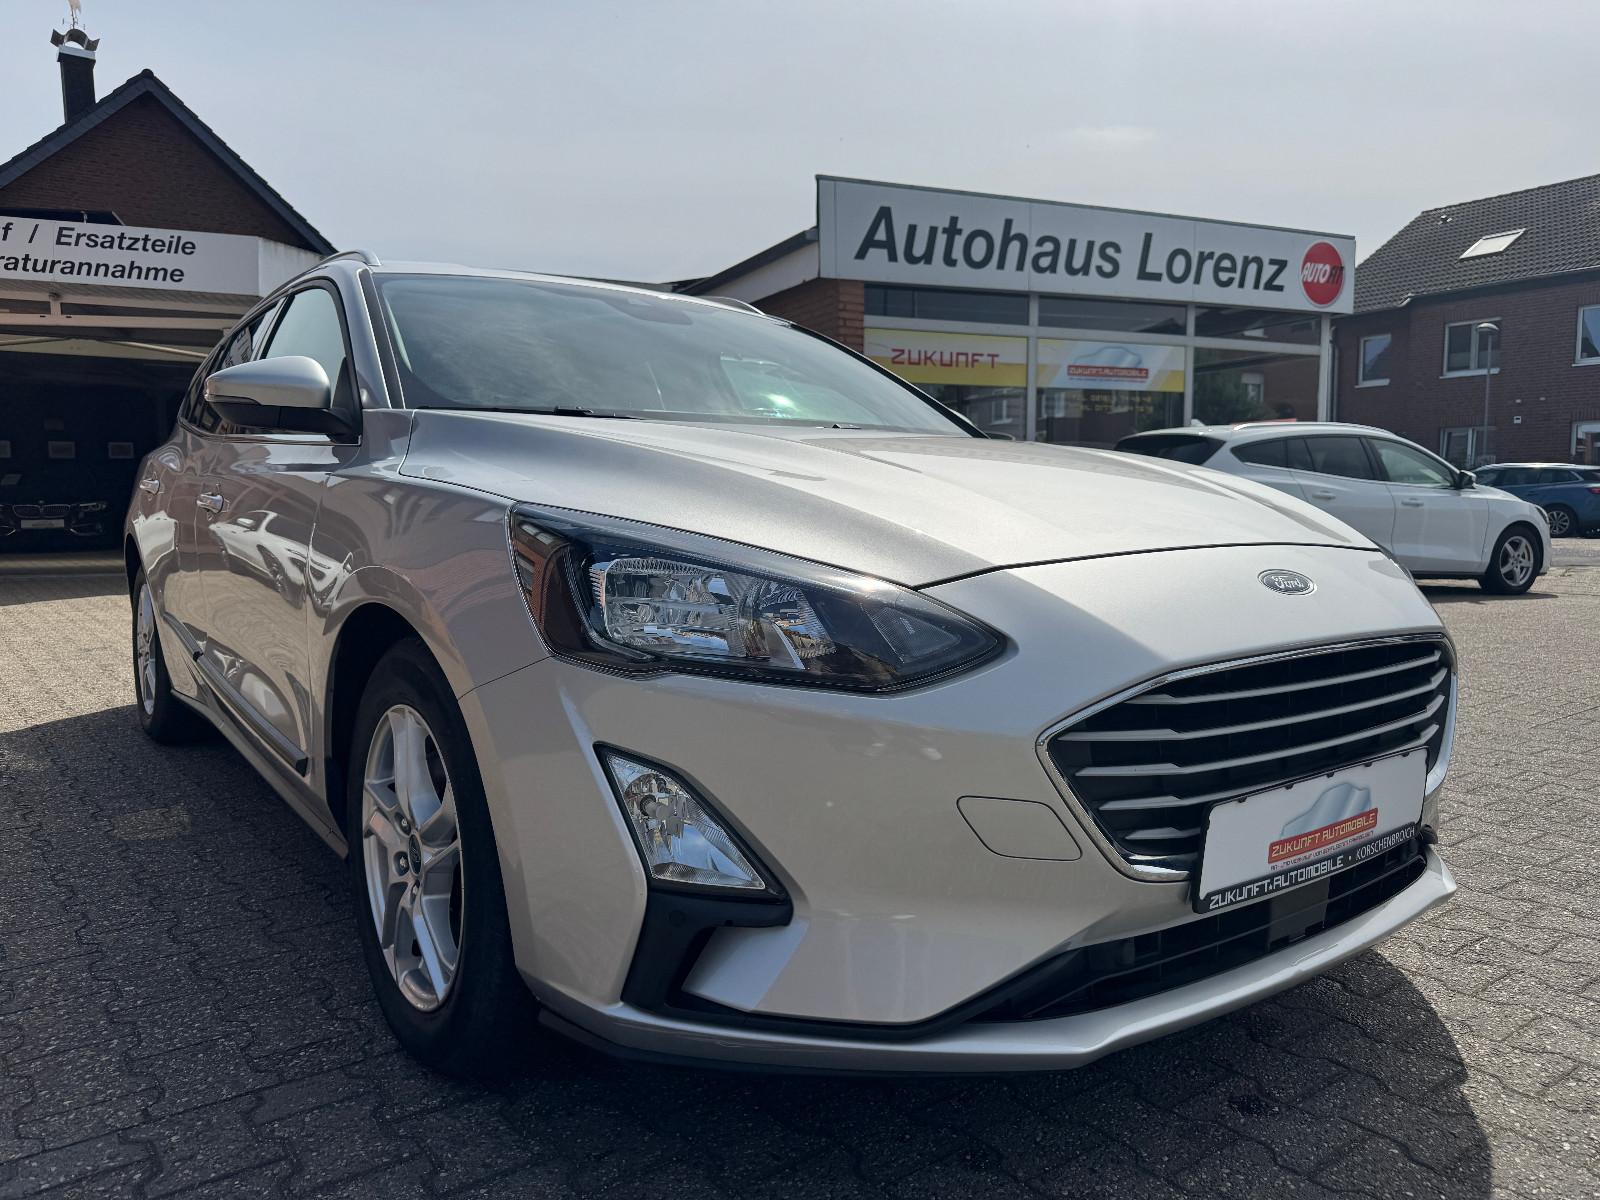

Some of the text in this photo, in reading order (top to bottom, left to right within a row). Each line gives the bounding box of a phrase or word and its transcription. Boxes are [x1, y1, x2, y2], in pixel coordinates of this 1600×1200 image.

[55, 226, 197, 256] Ersatzteile
[854, 205, 1288, 292] Autohaus Lorenz
[891, 348, 1000, 369] ZUKUNFT
[1271, 575, 1305, 589] Ford
[1271, 832, 1321, 858] ZUKUNFT
[1322, 812, 1376, 841] AUTOMOBILE
[1355, 825, 1416, 861] KORSCHENBROICH
